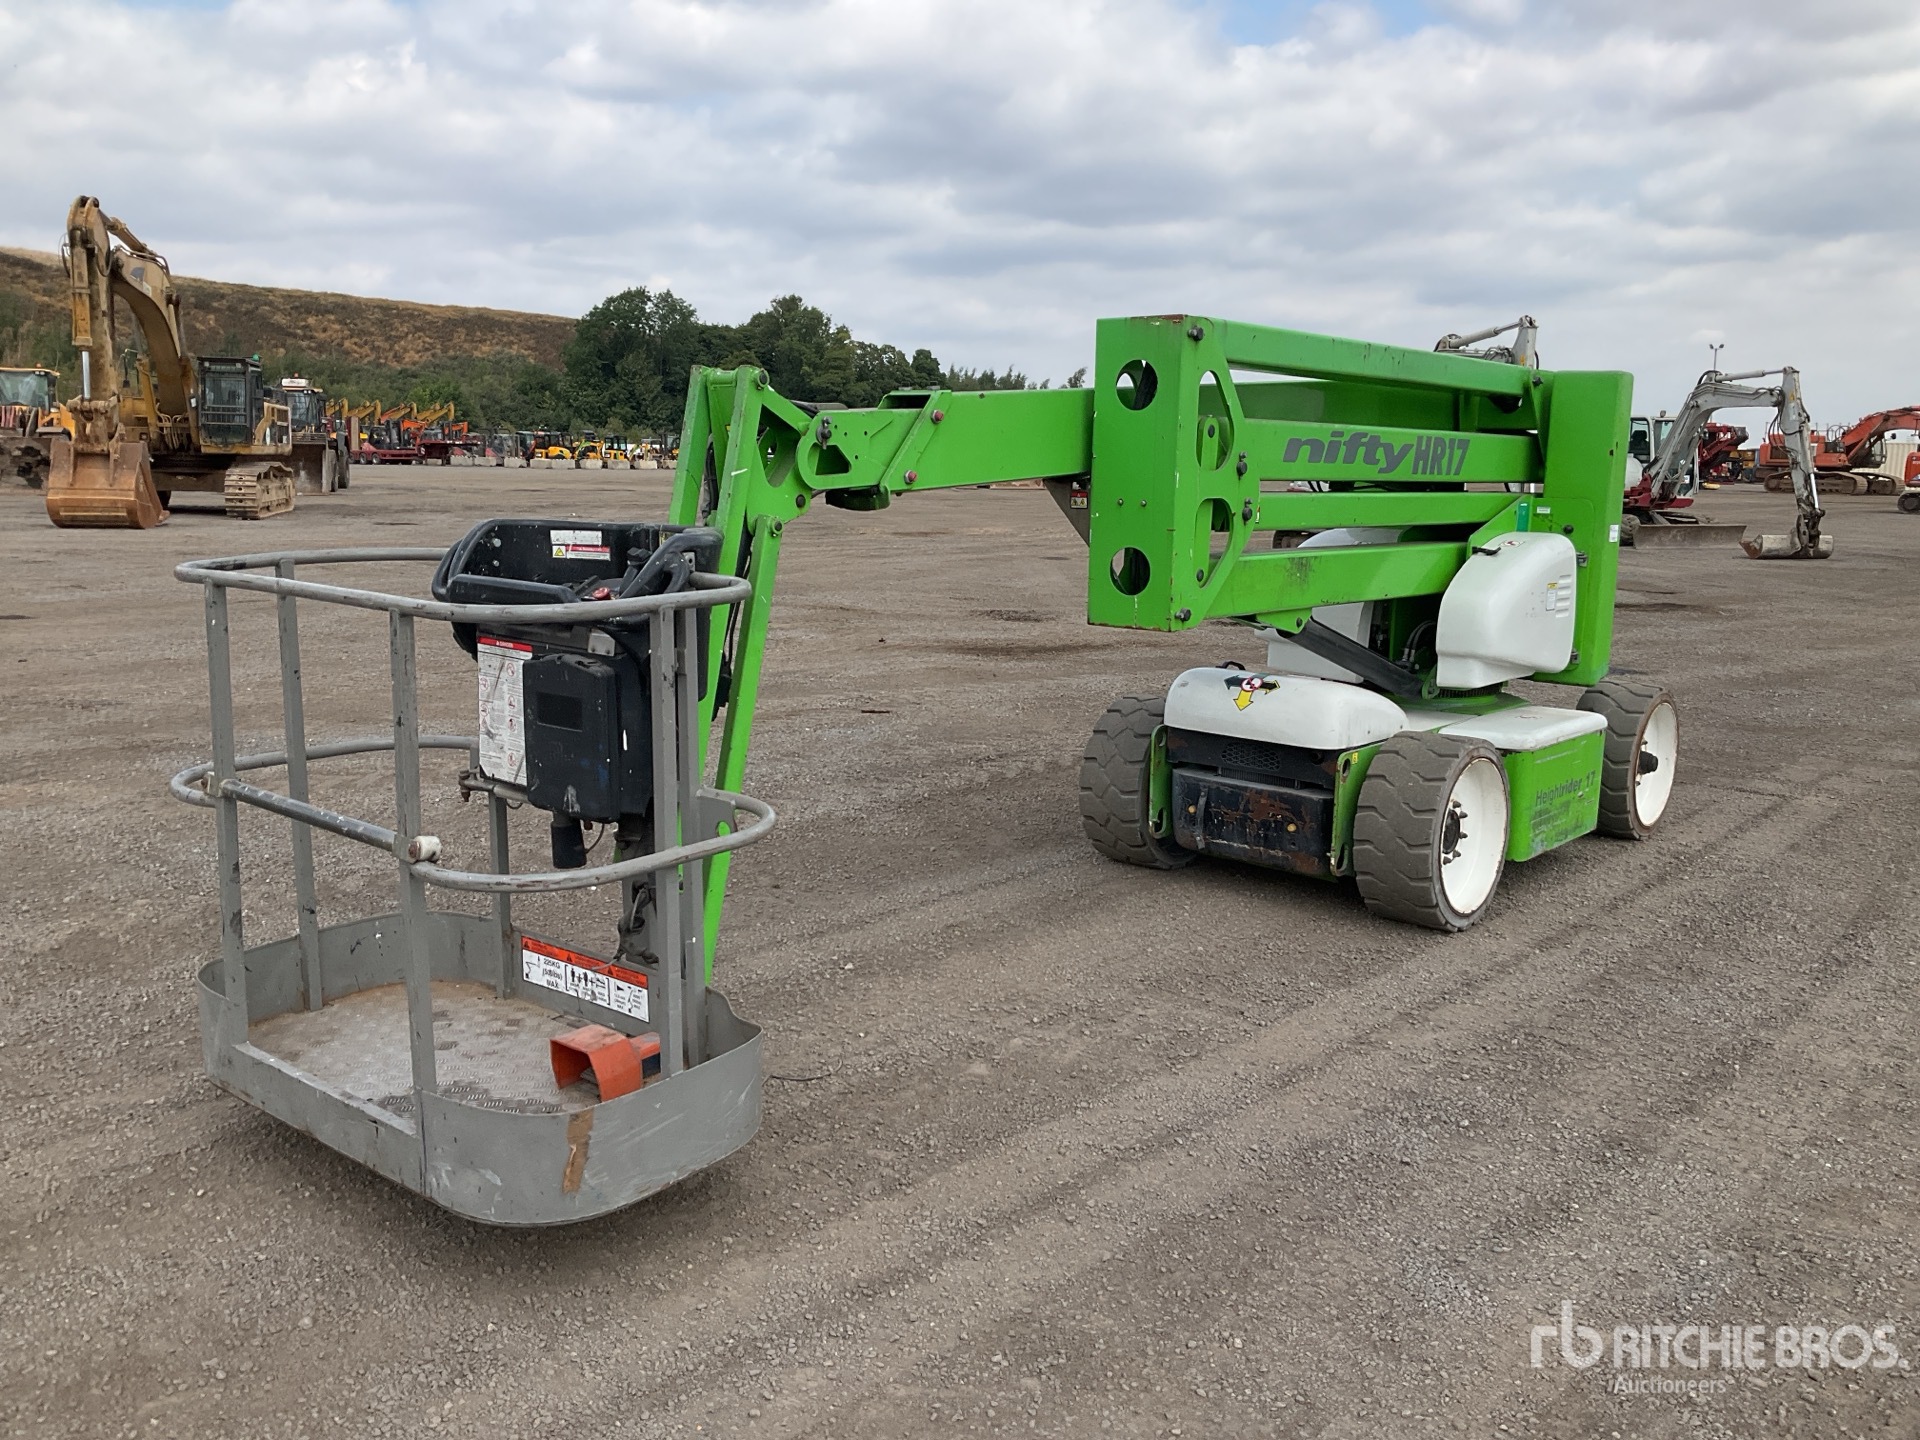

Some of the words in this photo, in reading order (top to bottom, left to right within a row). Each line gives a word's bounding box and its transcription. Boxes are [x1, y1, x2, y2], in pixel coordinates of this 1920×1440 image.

[1283, 431, 1414, 474] nifty
[1411, 435, 1470, 476] HR17
[1535, 777, 1583, 808] Heightrider
[1585, 769, 1597, 788] 17
